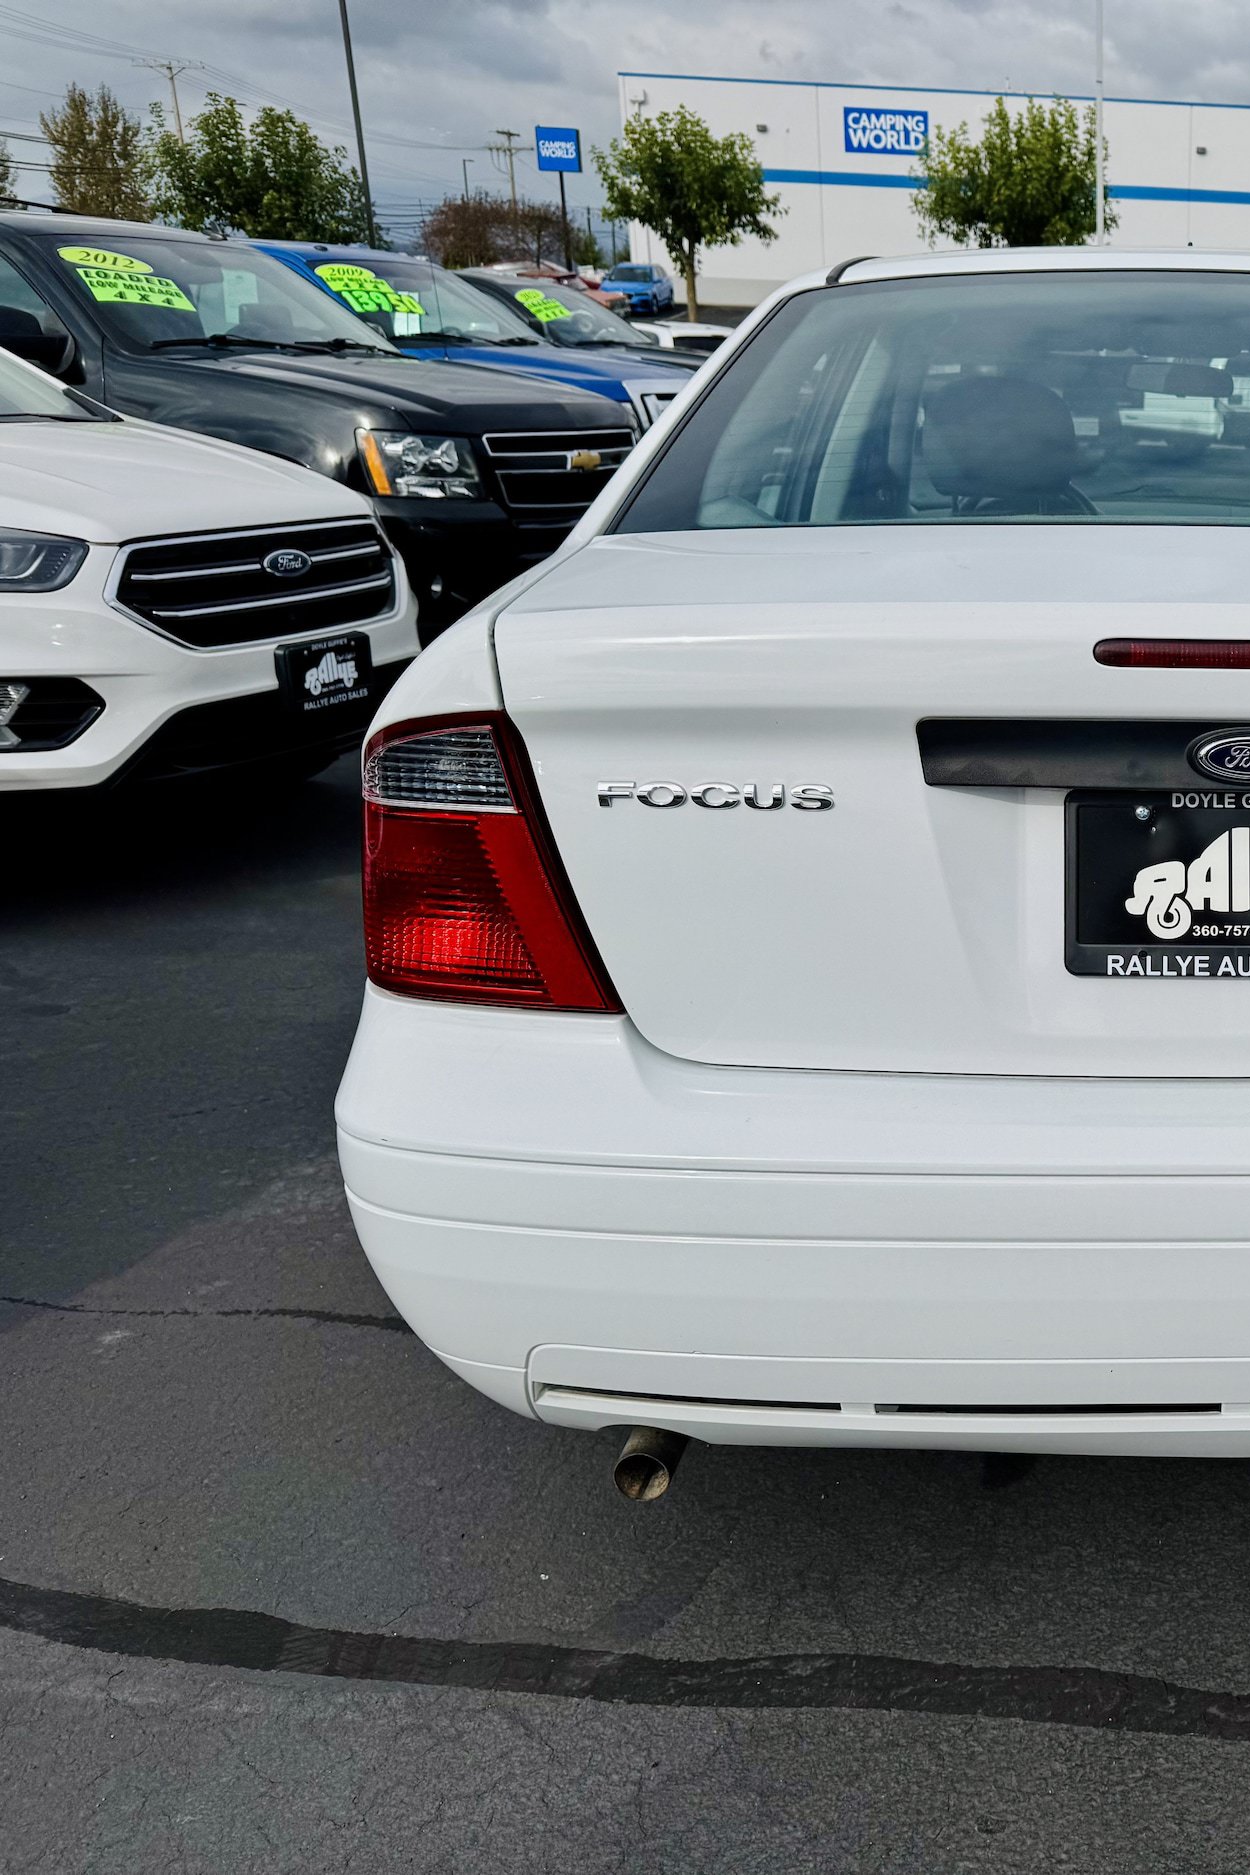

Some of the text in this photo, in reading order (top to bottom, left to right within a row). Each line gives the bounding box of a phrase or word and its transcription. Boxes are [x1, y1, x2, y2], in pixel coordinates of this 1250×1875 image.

[847, 112, 925, 132] CAMPING
[539, 140, 576, 150] CAMPING
[848, 128, 925, 150] WORLD
[540, 148, 577, 159] WORLD
[79, 250, 135, 269] 2012
[83, 269, 173, 288] LOADED
[328, 266, 363, 276] 2009
[89, 280, 183, 299] LOW MILEAGE
[114, 291, 175, 306] 4 X 4
[341, 290, 426, 315] 13950
[278, 555, 303, 571] Ford
[304, 698, 329, 710] RALLYE
[329, 693, 348, 705] AUTO
[347, 688, 369, 700] SALES
[597, 781, 836, 811] FOCUS
[1171, 793, 1236, 808] DOYLE
[1107, 954, 1210, 977] RALLYE
